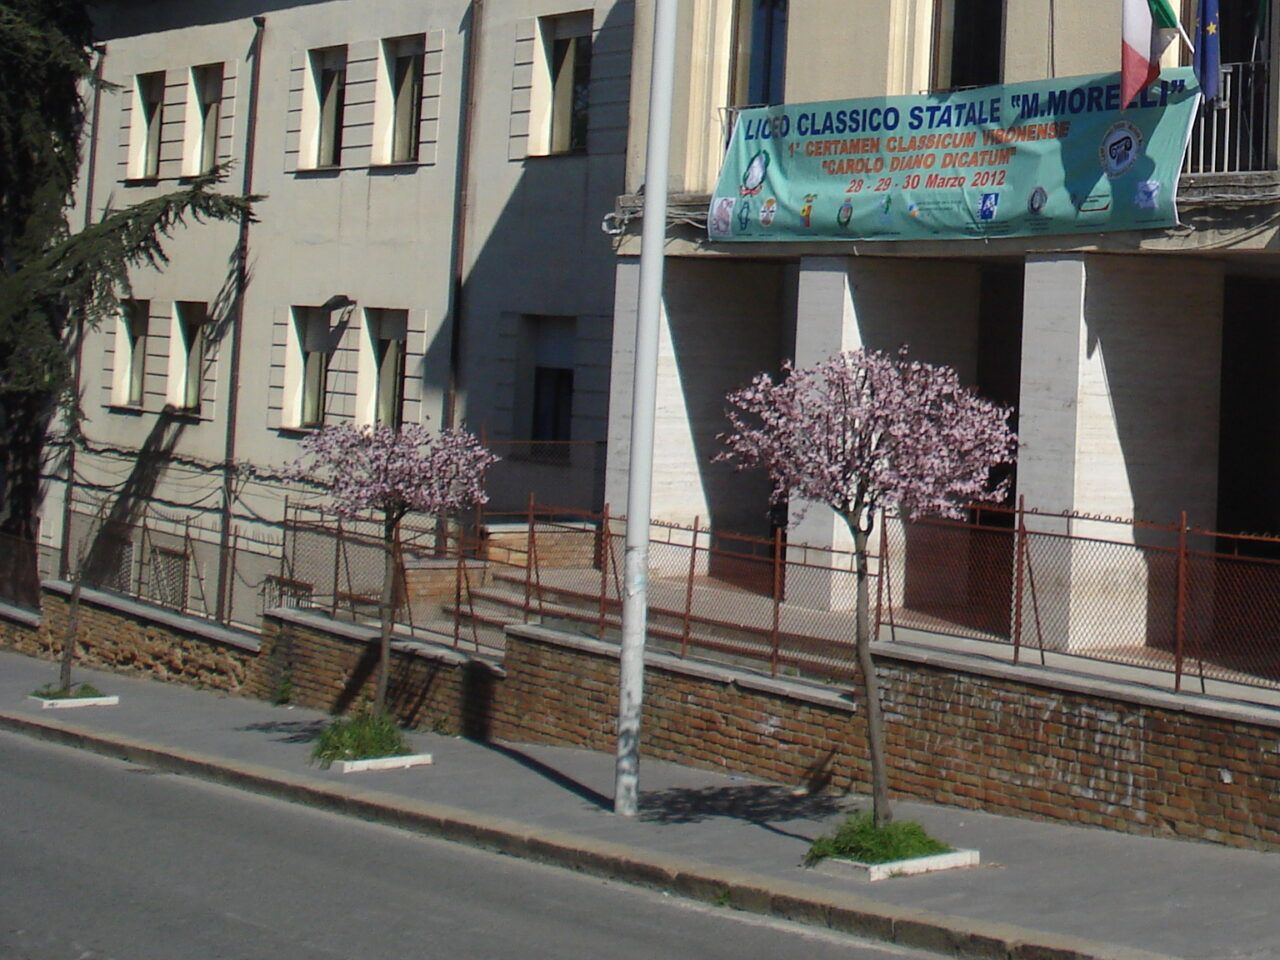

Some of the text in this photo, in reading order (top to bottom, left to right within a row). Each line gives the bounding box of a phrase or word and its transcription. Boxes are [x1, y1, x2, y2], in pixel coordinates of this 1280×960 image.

[744, 115, 791, 140] LICEO
[797, 107, 900, 136] CLASSICO
[908, 99, 1002, 130] STATALE
[805, 137, 880, 157] CERTAMEN
[886, 131, 976, 153] CLASSICUM
[889, 153, 935, 173] DIANO
[846, 179, 864, 193] 28
[874, 177, 892, 192] 29
[902, 174, 920, 190] 30
[925, 173, 966, 189] Marzo
[971, 170, 1007, 187] 2012
